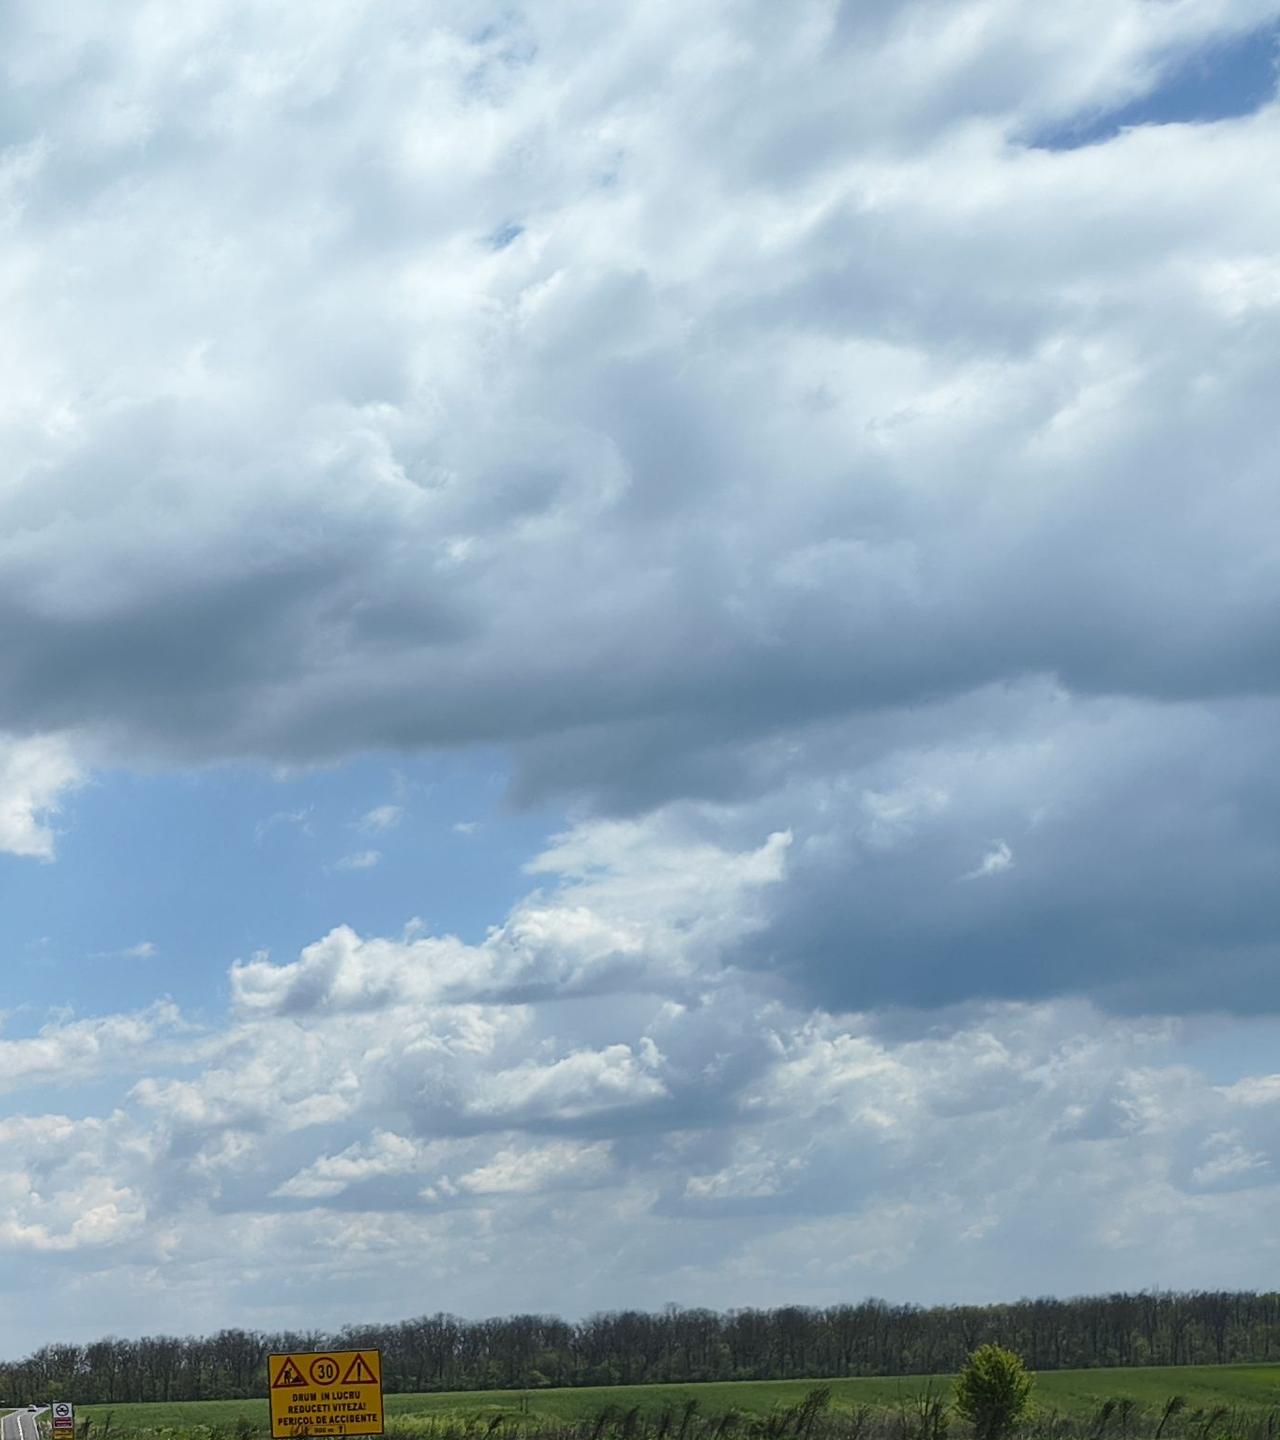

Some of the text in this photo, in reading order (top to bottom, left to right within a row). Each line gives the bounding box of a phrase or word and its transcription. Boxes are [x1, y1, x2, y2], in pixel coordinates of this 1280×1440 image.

[318, 1364, 333, 1379] 30
[292, 1391, 360, 1402] DRUM IN LUCRU
[278, 1413, 377, 1426] PERICOL DE ACCIDENTE
